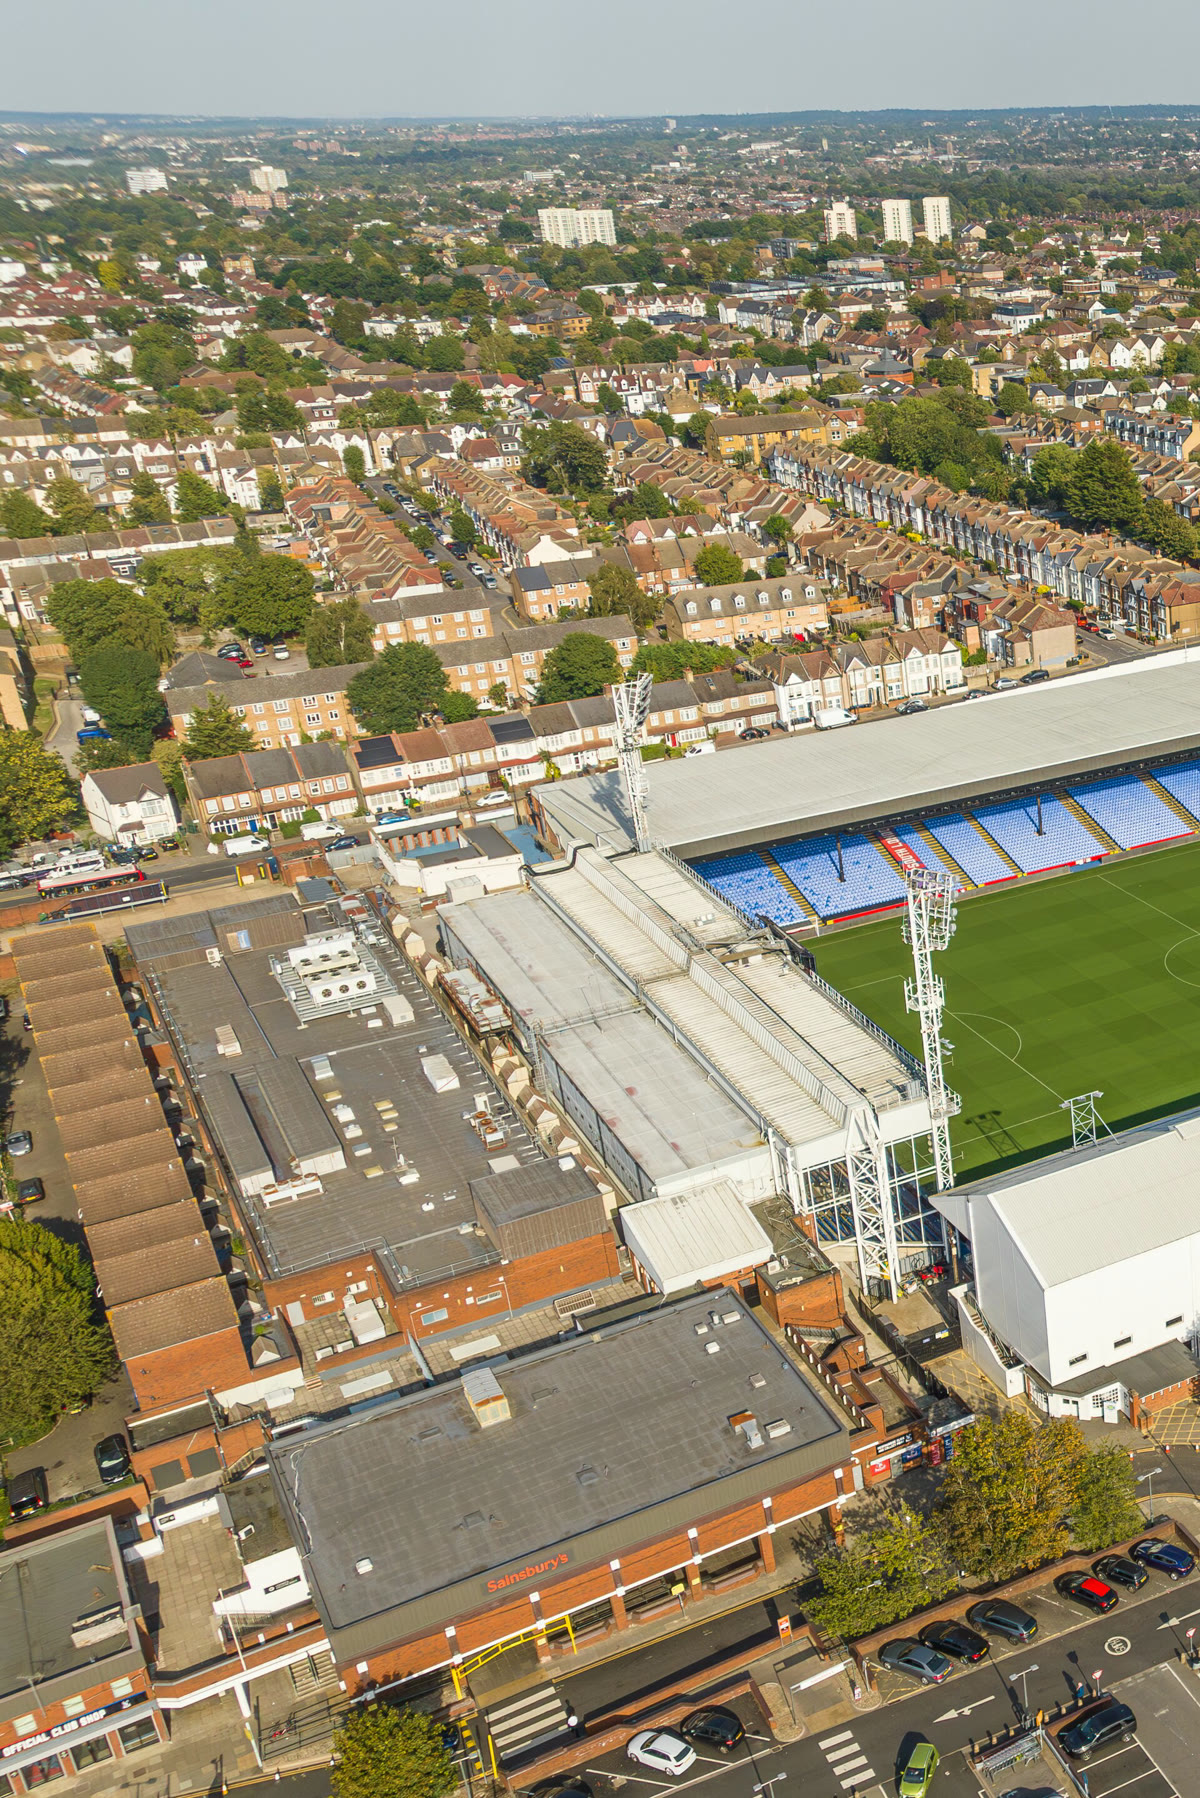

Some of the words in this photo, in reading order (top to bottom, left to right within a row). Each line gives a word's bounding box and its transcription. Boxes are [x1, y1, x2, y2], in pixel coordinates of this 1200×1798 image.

[487, 1553, 569, 1593] Sainsbury's
[2, 1731, 51, 1758] OFFICIAL
[50, 1718, 79, 1739] CLUB
[79, 1708, 107, 1727] SHOP
